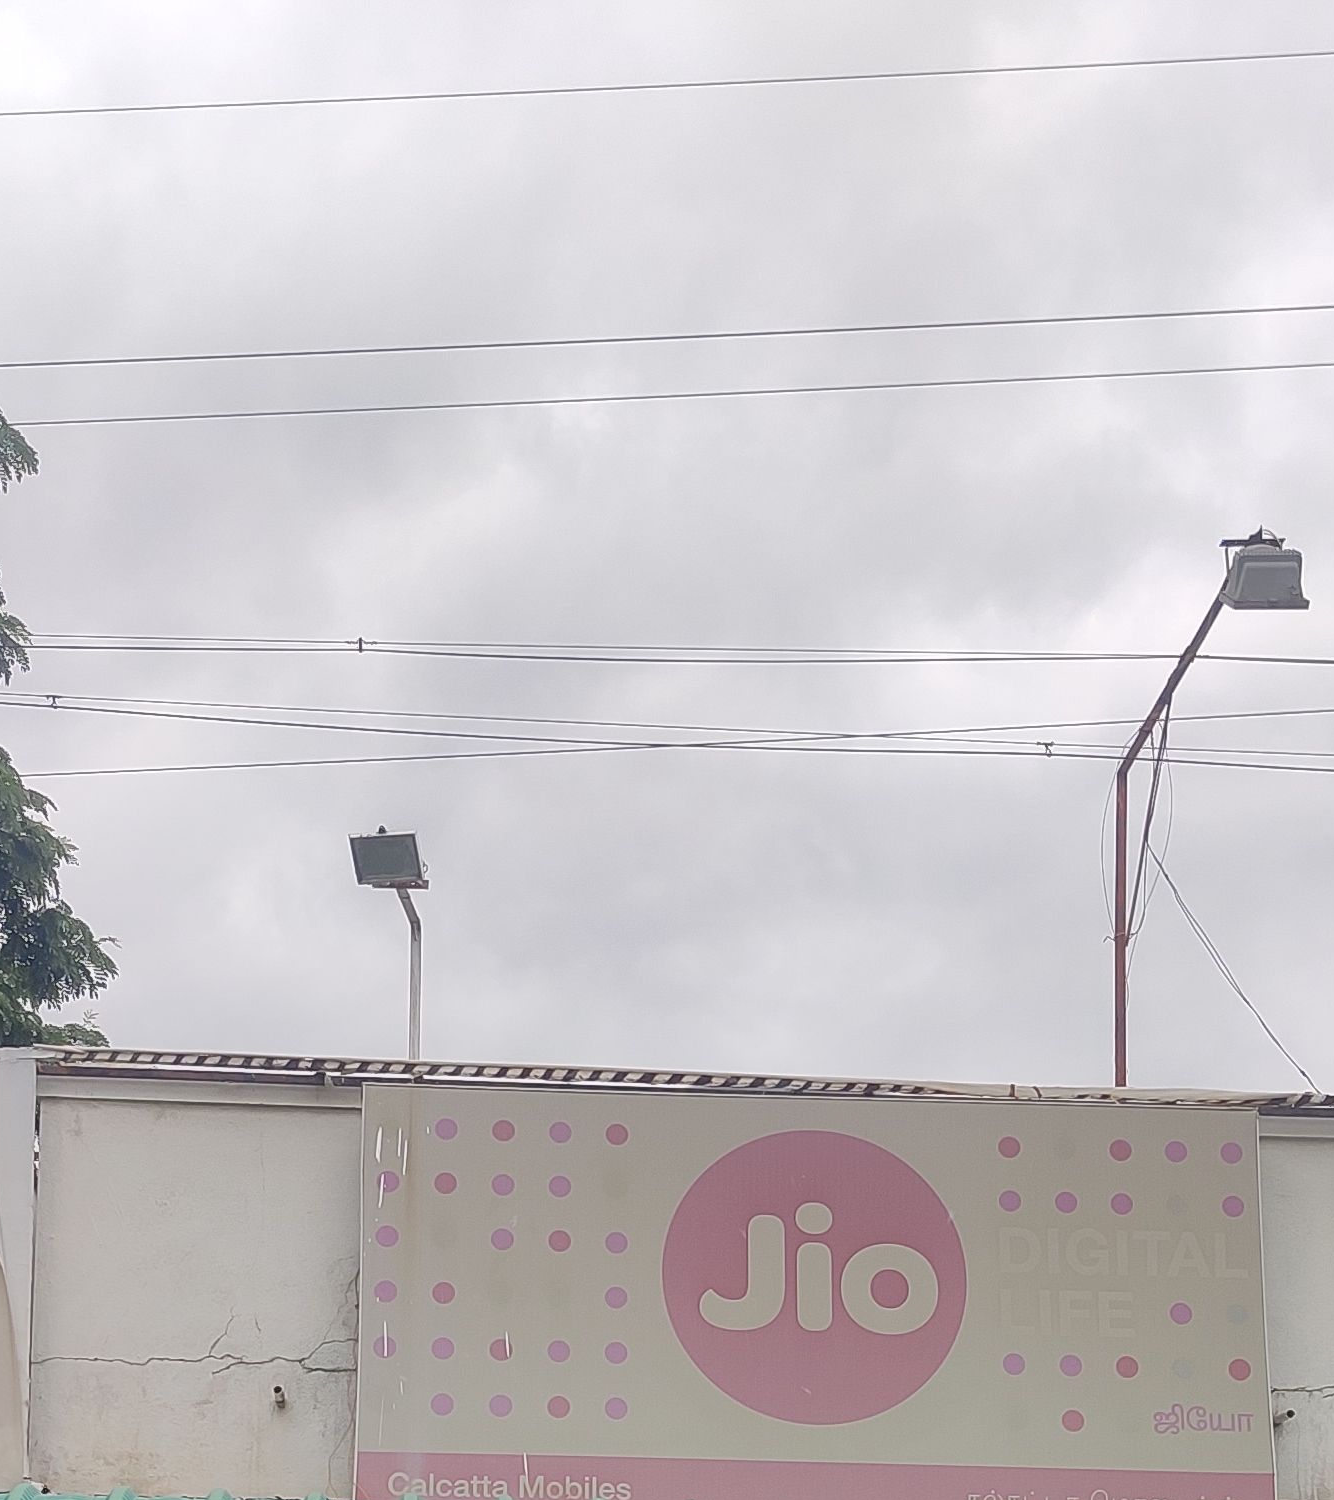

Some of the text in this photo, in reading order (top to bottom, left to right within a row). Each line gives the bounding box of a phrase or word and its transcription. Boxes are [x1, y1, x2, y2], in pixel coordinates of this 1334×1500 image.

[699, 1202, 938, 1335] Jio
[998, 1227, 1249, 1279] DIGITAL
[1000, 1289, 1136, 1338] LIFE
[1153, 1403, 1254, 1434] ஜியோ
[387, 1472, 633, 1500] Calcatta Mobiles
